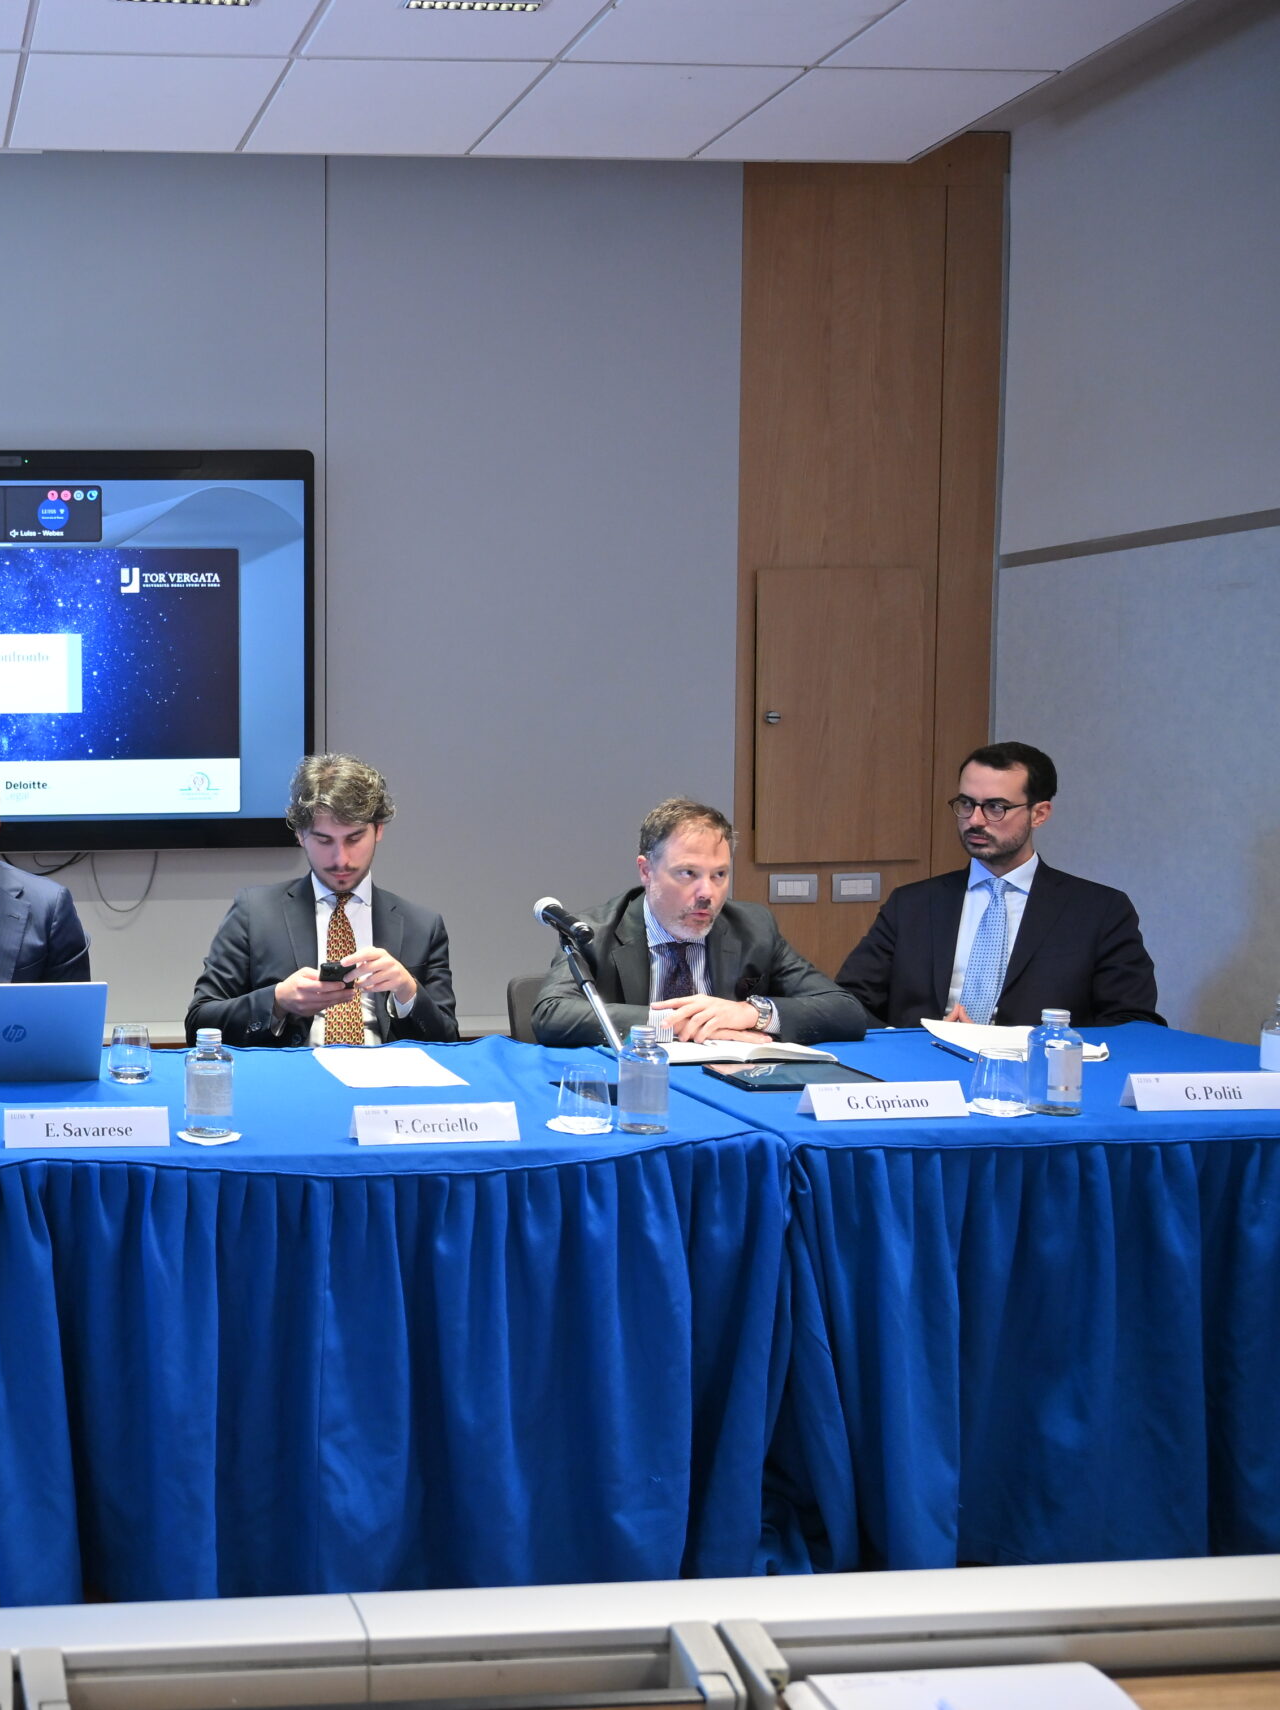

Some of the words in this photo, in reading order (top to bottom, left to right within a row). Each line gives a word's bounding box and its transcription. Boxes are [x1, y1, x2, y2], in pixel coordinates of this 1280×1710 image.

[20, 529, 37, 537] Luiss
[42, 529, 65, 537] Webex
[142, 572, 167, 583] TOR
[167, 572, 221, 583] VERGATA
[5, 780, 48, 791] Deloitte
[2, 1024, 27, 1043] hp
[1184, 1086, 1201, 1101] G.
[1203, 1085, 1243, 1100] Politi
[847, 1095, 864, 1110] G.
[865, 1094, 929, 1113] Cipriano
[45, 1122, 60, 1138] E.
[63, 1122, 133, 1138] Savarese
[393, 1119, 409, 1134] F.
[411, 1117, 478, 1134] Cerciello
